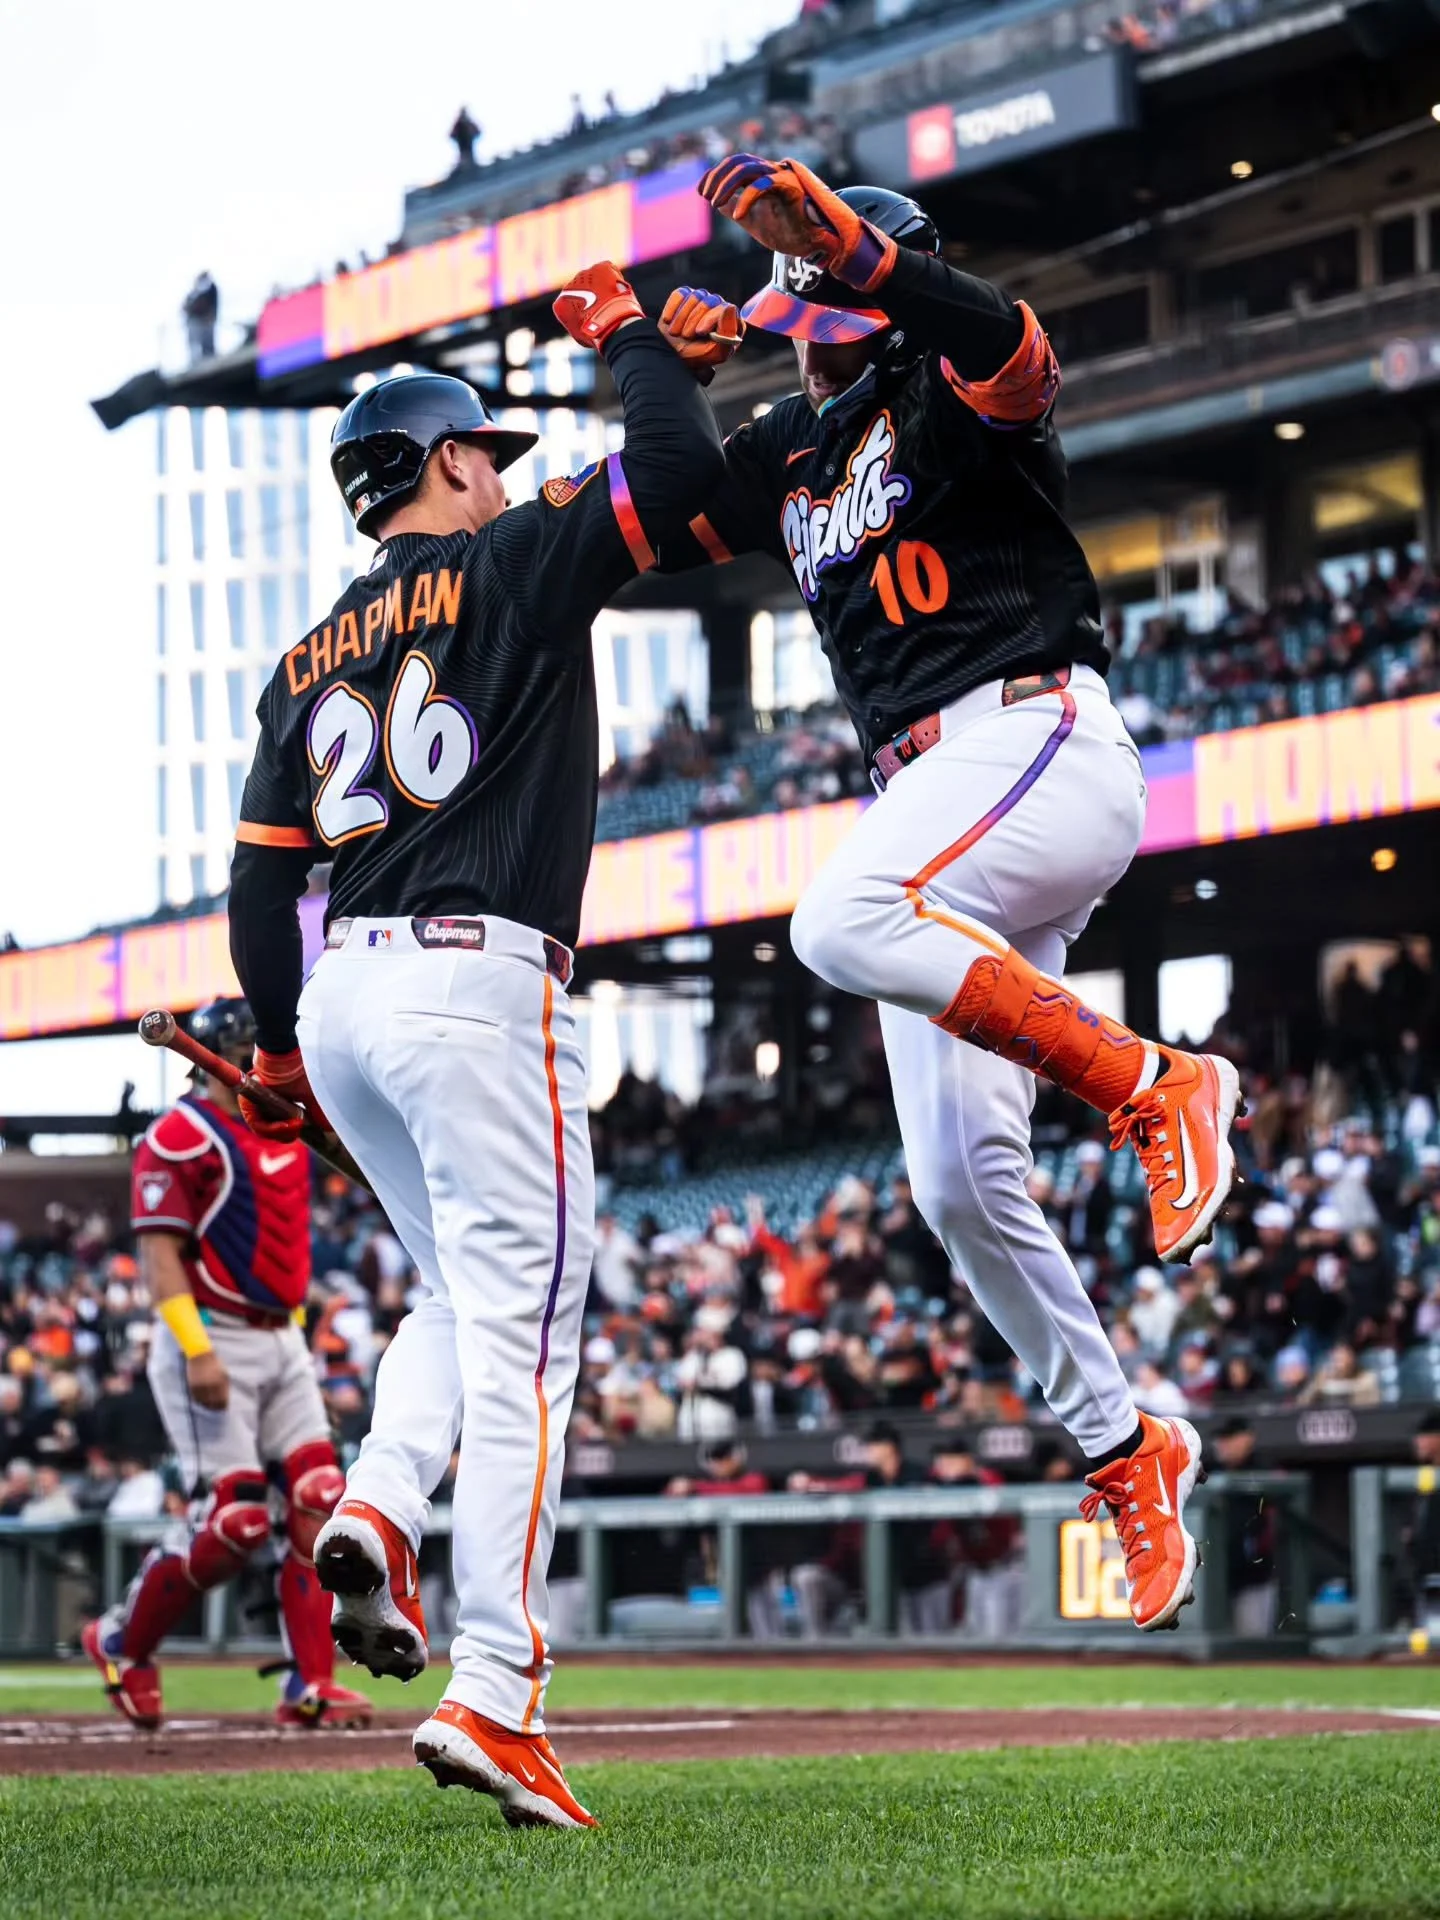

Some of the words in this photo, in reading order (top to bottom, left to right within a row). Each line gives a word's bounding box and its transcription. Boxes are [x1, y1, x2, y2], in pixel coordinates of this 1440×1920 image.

[325, 227, 491, 358] HOME
[780, 408, 912, 602] Giants
[284, 568, 463, 696] CHAPMAN
[869, 540, 949, 625] 10
[306, 650, 479, 848] 26
[0, 933, 114, 1038] OME
[424, 922, 481, 942] Chapman
